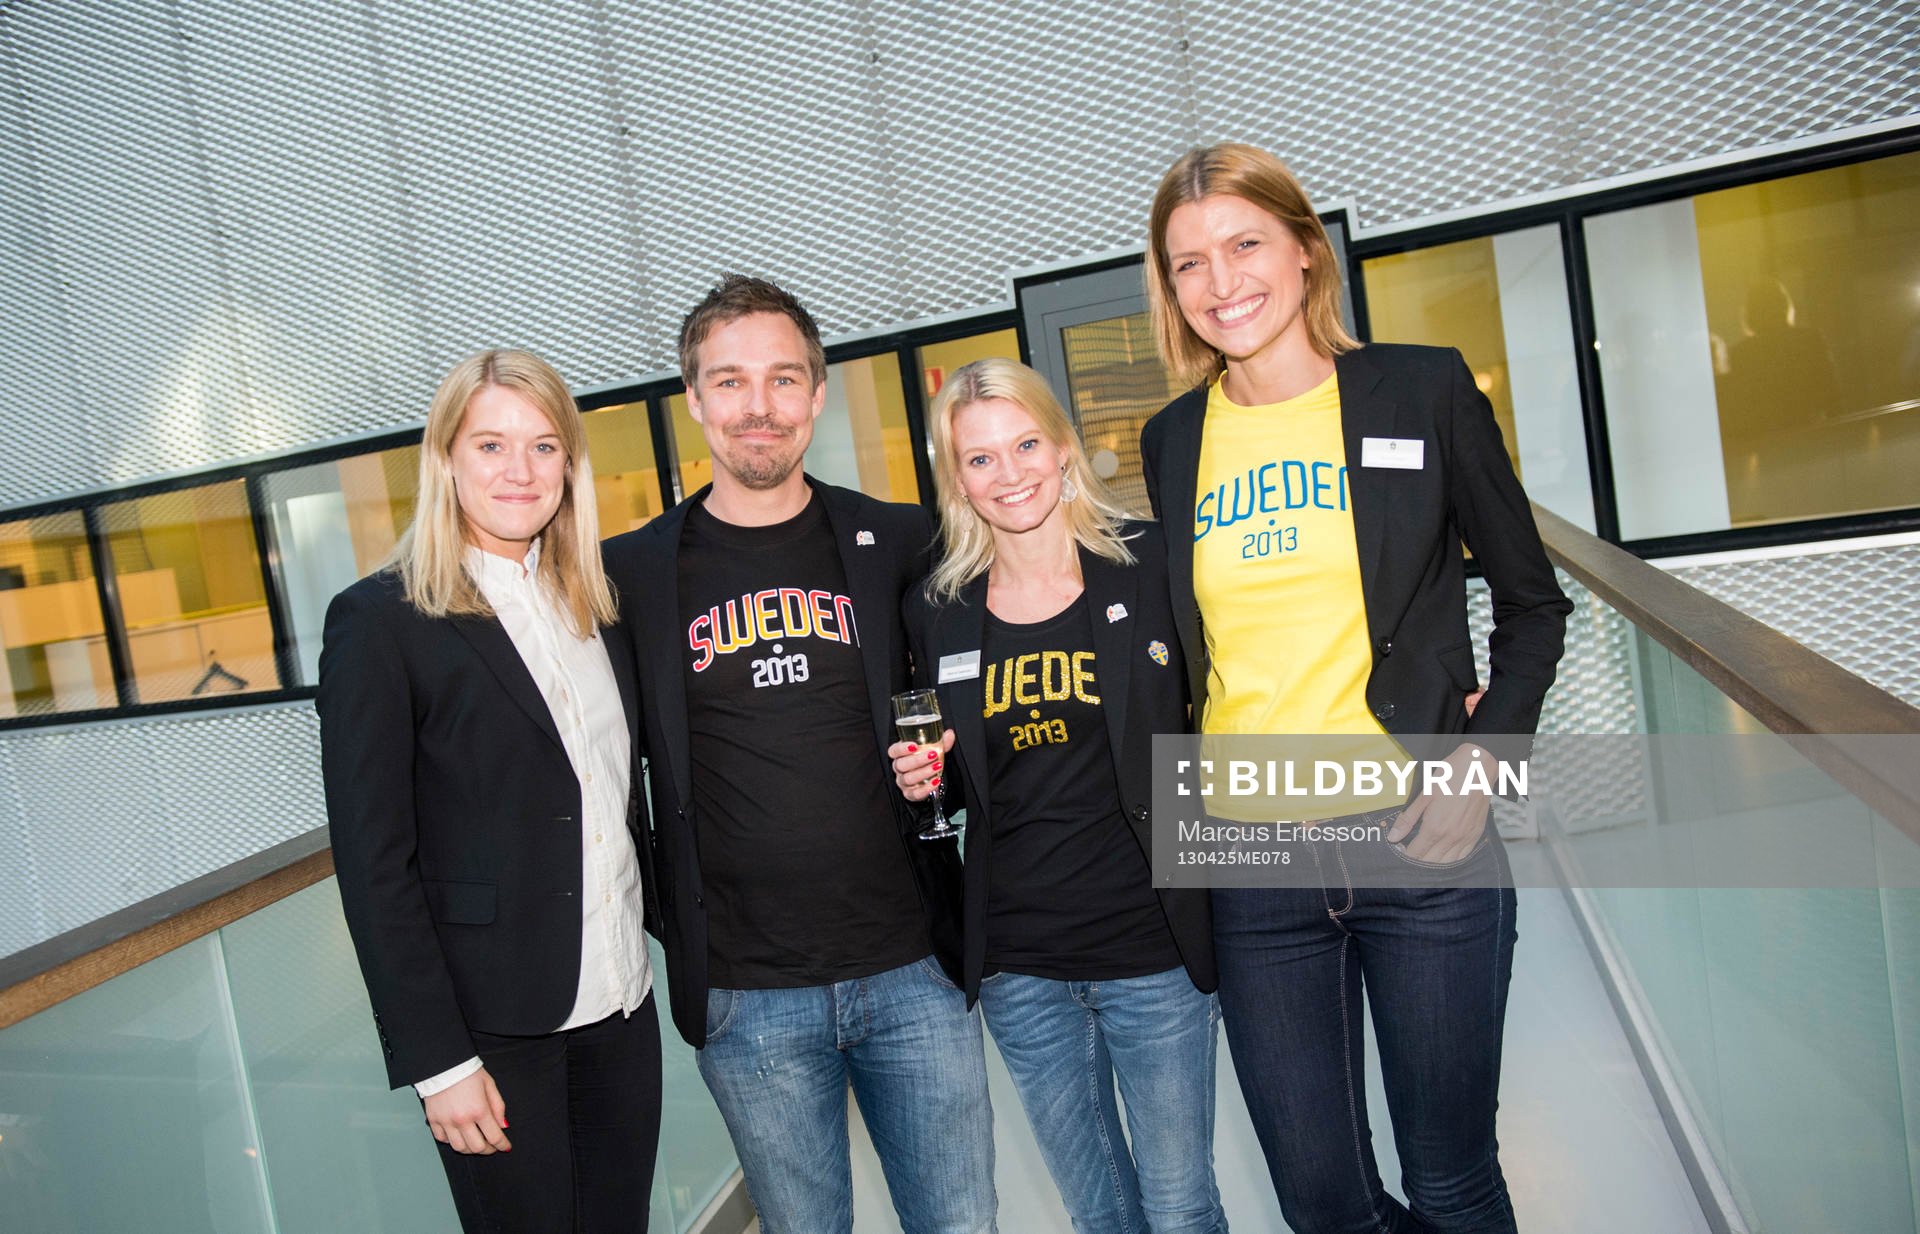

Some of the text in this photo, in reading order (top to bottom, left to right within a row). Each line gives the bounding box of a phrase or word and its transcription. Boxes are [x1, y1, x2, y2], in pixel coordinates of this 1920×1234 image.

[1242, 526, 1297, 559] 2013
[688, 587, 860, 672] SWEDEN
[751, 653, 809, 688] 2013
[982, 650, 1101, 719] WEDE
[1009, 718, 1069, 751] 2013
